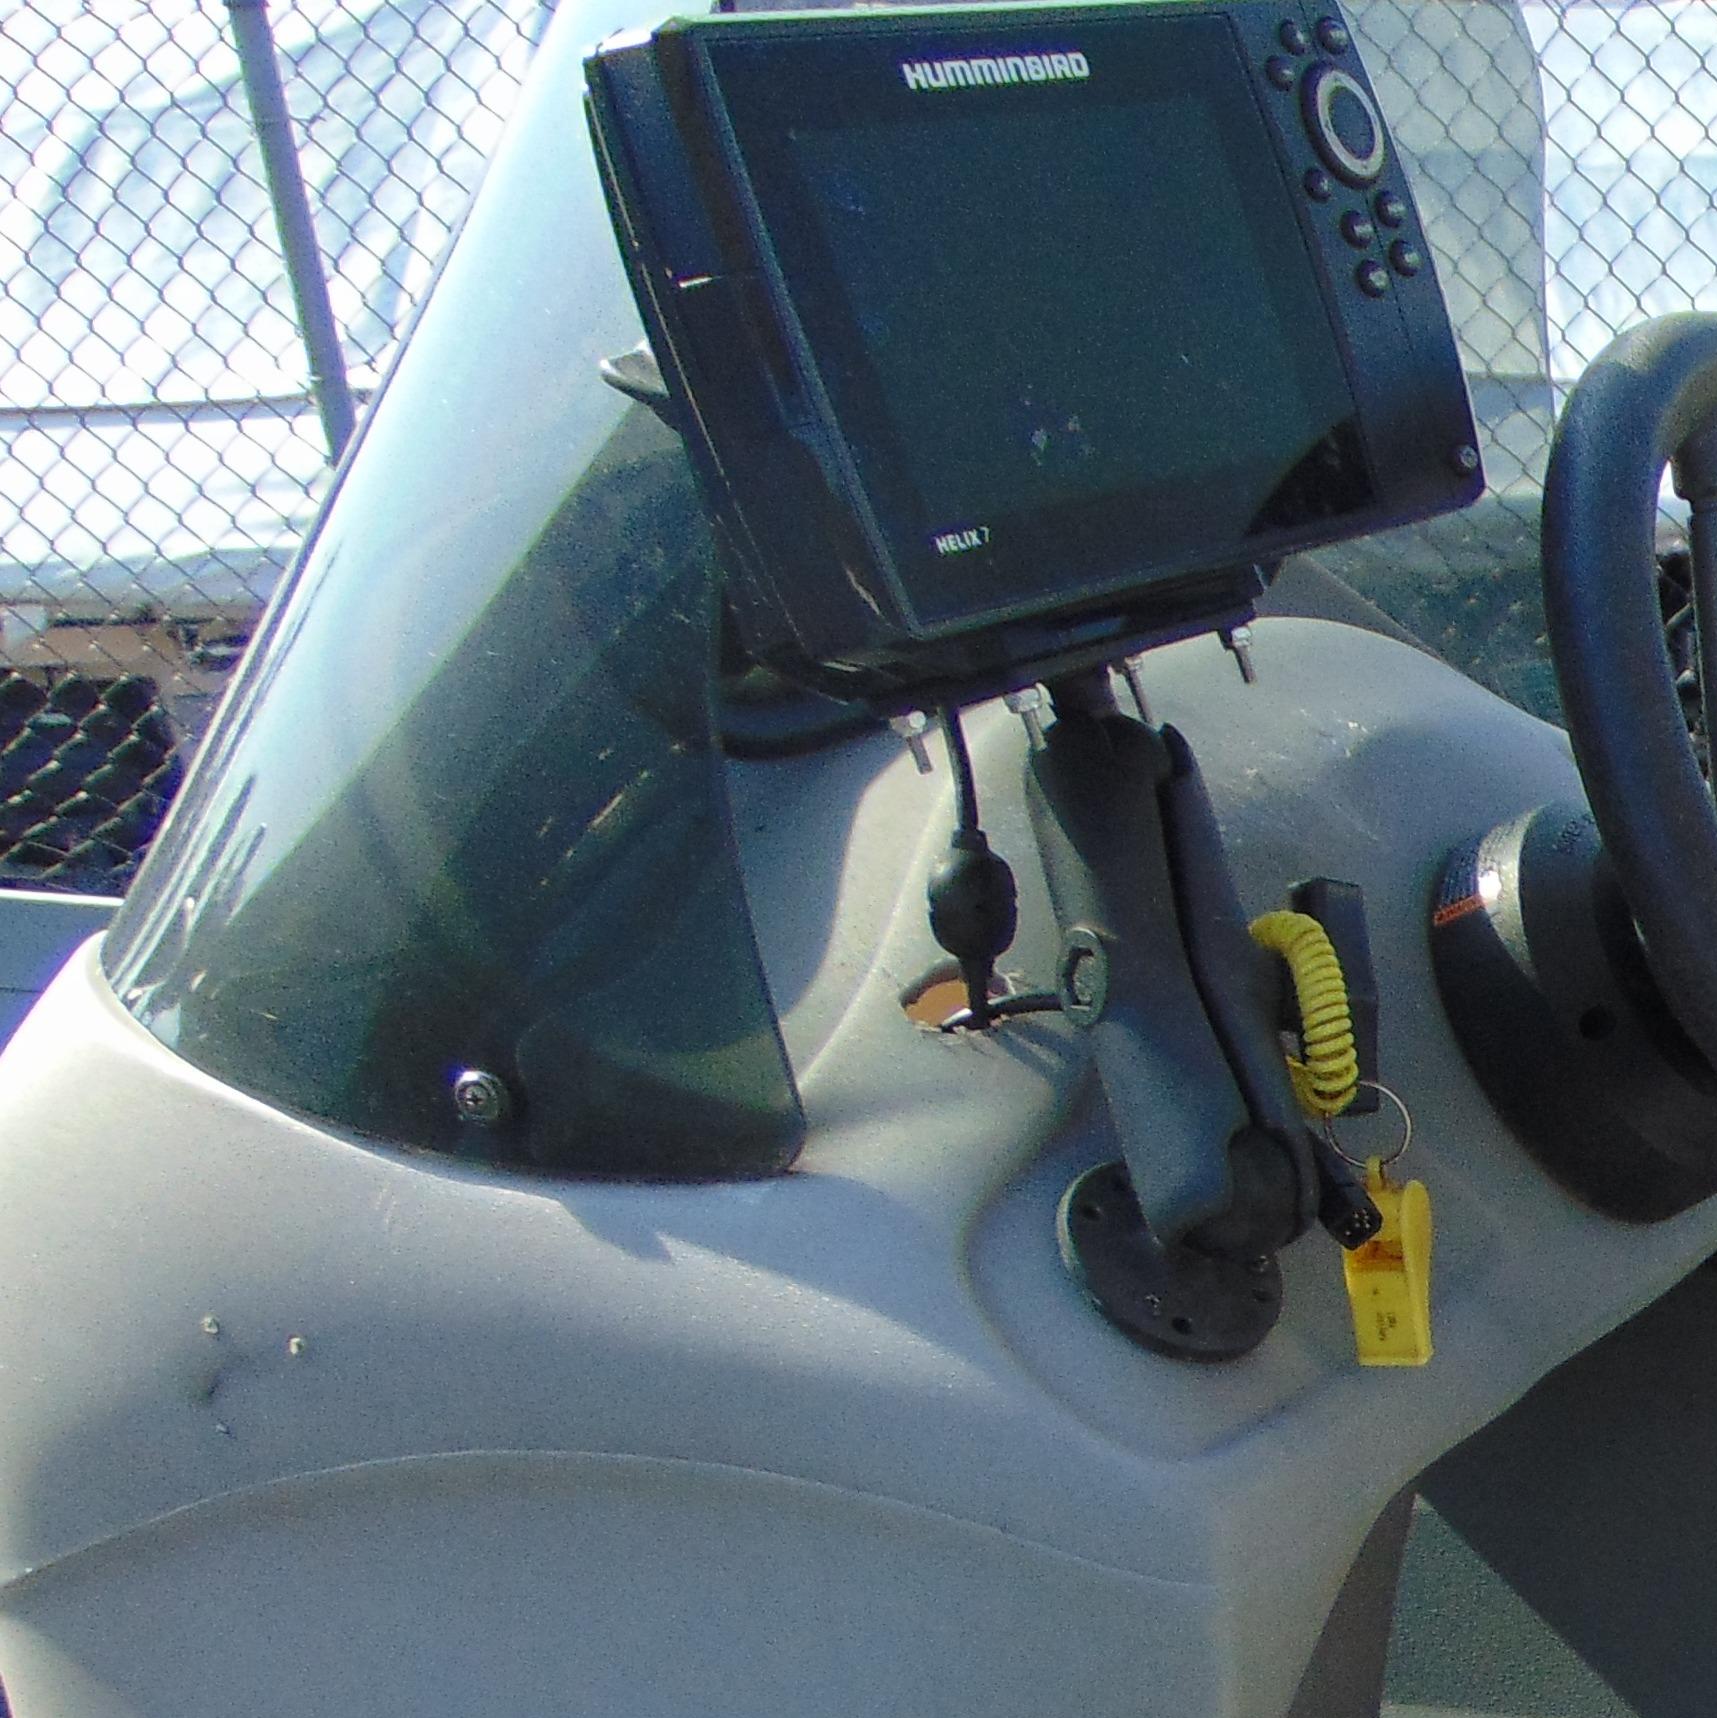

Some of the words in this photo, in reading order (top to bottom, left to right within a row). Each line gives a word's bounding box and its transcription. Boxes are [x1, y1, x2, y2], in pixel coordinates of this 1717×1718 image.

[902, 52, 1090, 90] HUMMINBIRD
[934, 529, 982, 554] HELIX
[979, 526, 990, 543] 7
